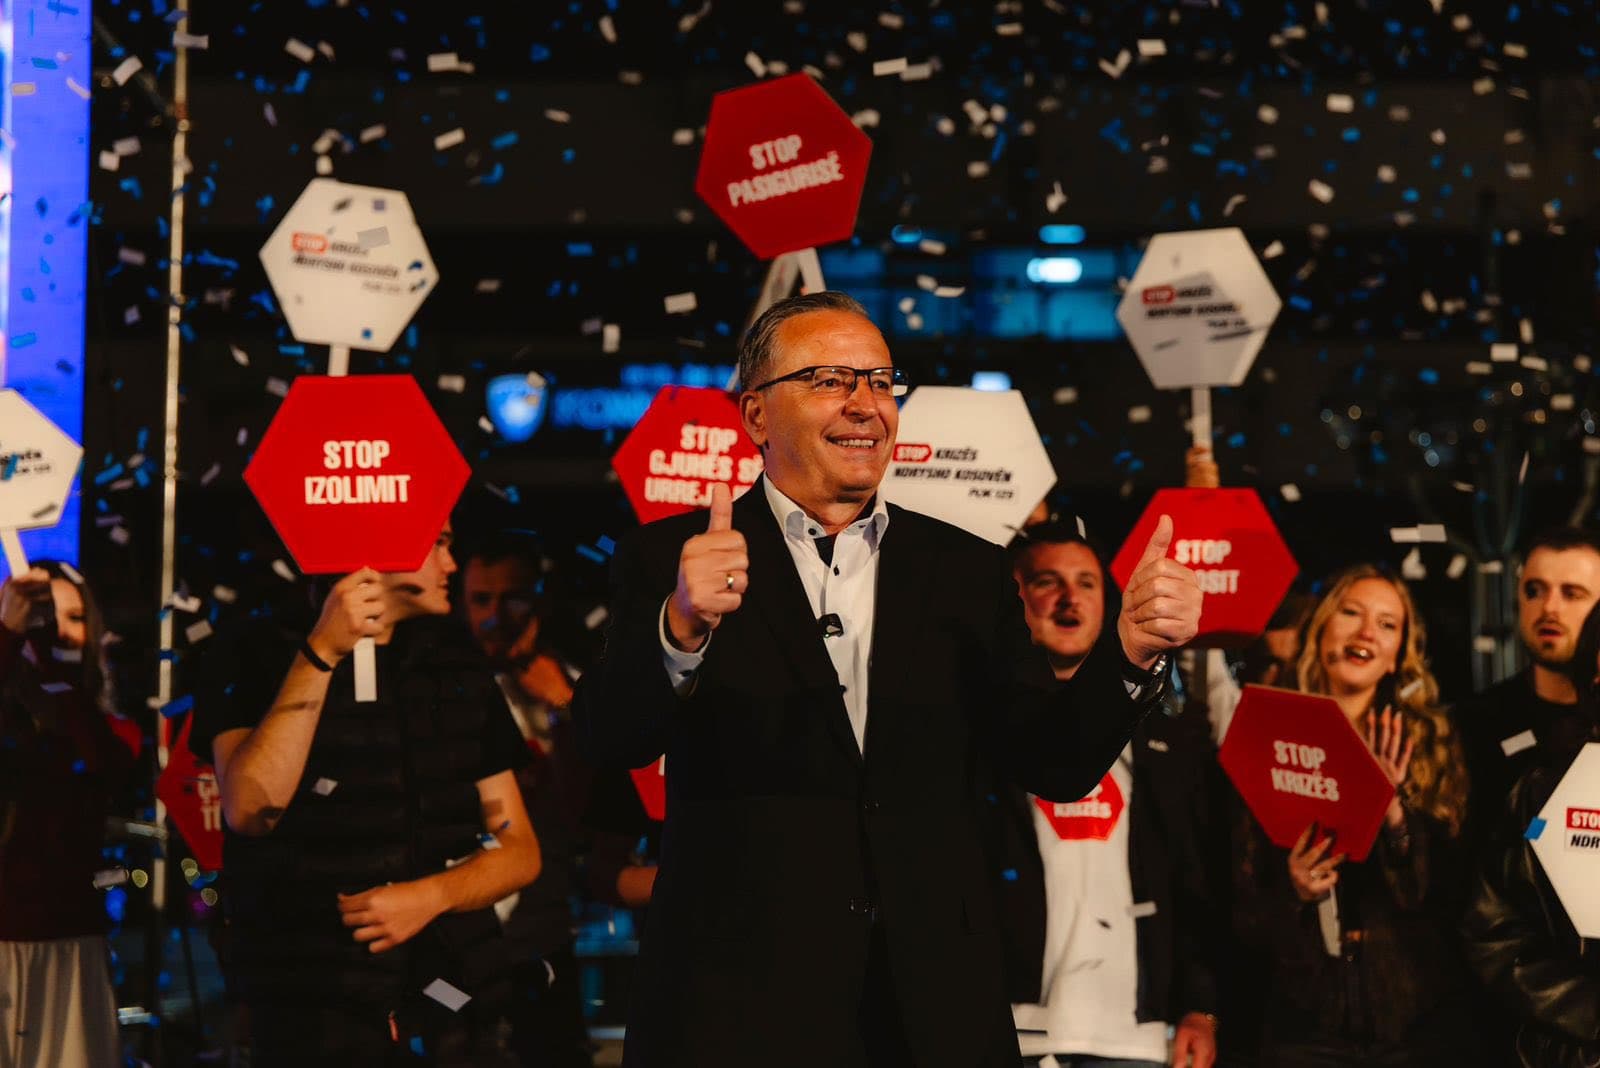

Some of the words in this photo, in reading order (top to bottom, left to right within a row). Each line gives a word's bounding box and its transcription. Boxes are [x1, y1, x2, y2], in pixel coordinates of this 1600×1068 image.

[750, 134, 802, 170] STOP
[680, 423, 738, 454] STOP
[897, 445, 929, 460] STOP
[323, 439, 390, 469] STOP
[304, 474, 411, 505] IZOLIMIT
[644, 477, 752, 507] URREJ
[1175, 539, 1232, 565] STOP
[1195, 569, 1240, 594] OSIT
[1273, 740, 1327, 769] STOP
[1270, 767, 1340, 802] KRIZËS
[1571, 810, 1600, 829] STO
